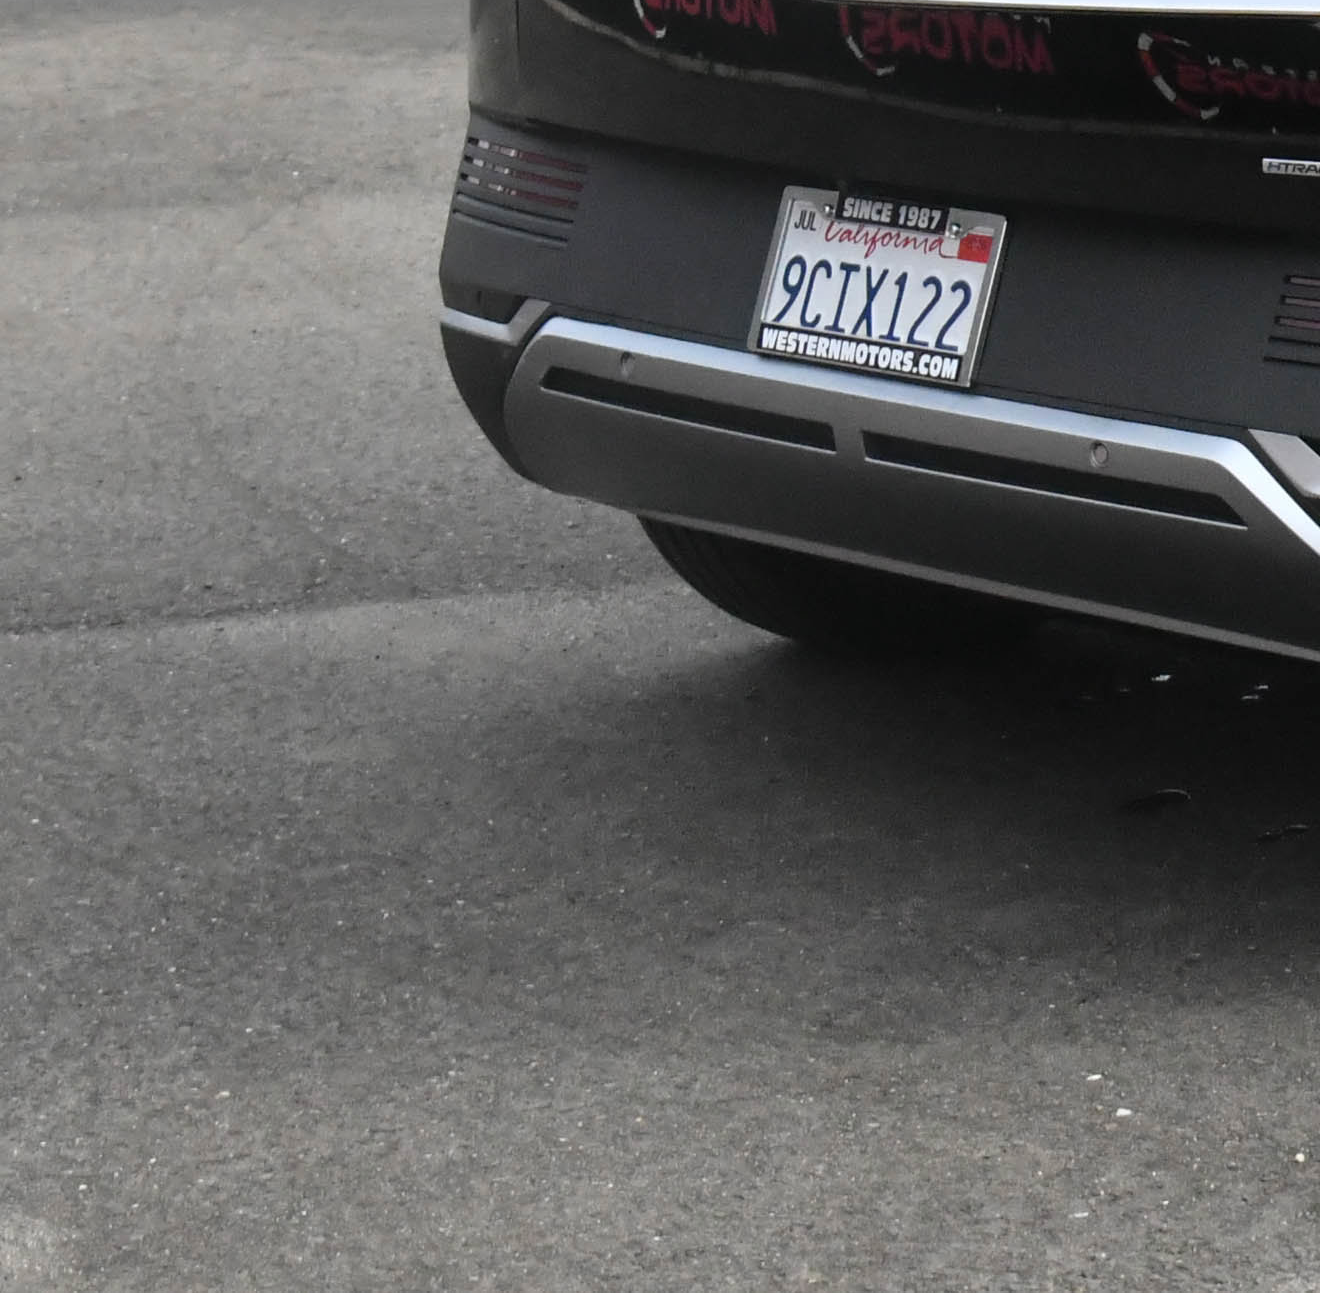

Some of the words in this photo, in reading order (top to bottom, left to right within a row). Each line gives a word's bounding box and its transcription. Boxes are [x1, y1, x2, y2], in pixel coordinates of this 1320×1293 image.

[793, 209, 817, 232] JUL
[842, 196, 894, 226] SINCE
[898, 205, 942, 231] 1987
[824, 220, 945, 259] California
[773, 254, 972, 352] 9CIX122
[761, 326, 960, 380] WESTERNMOTORS.COM
